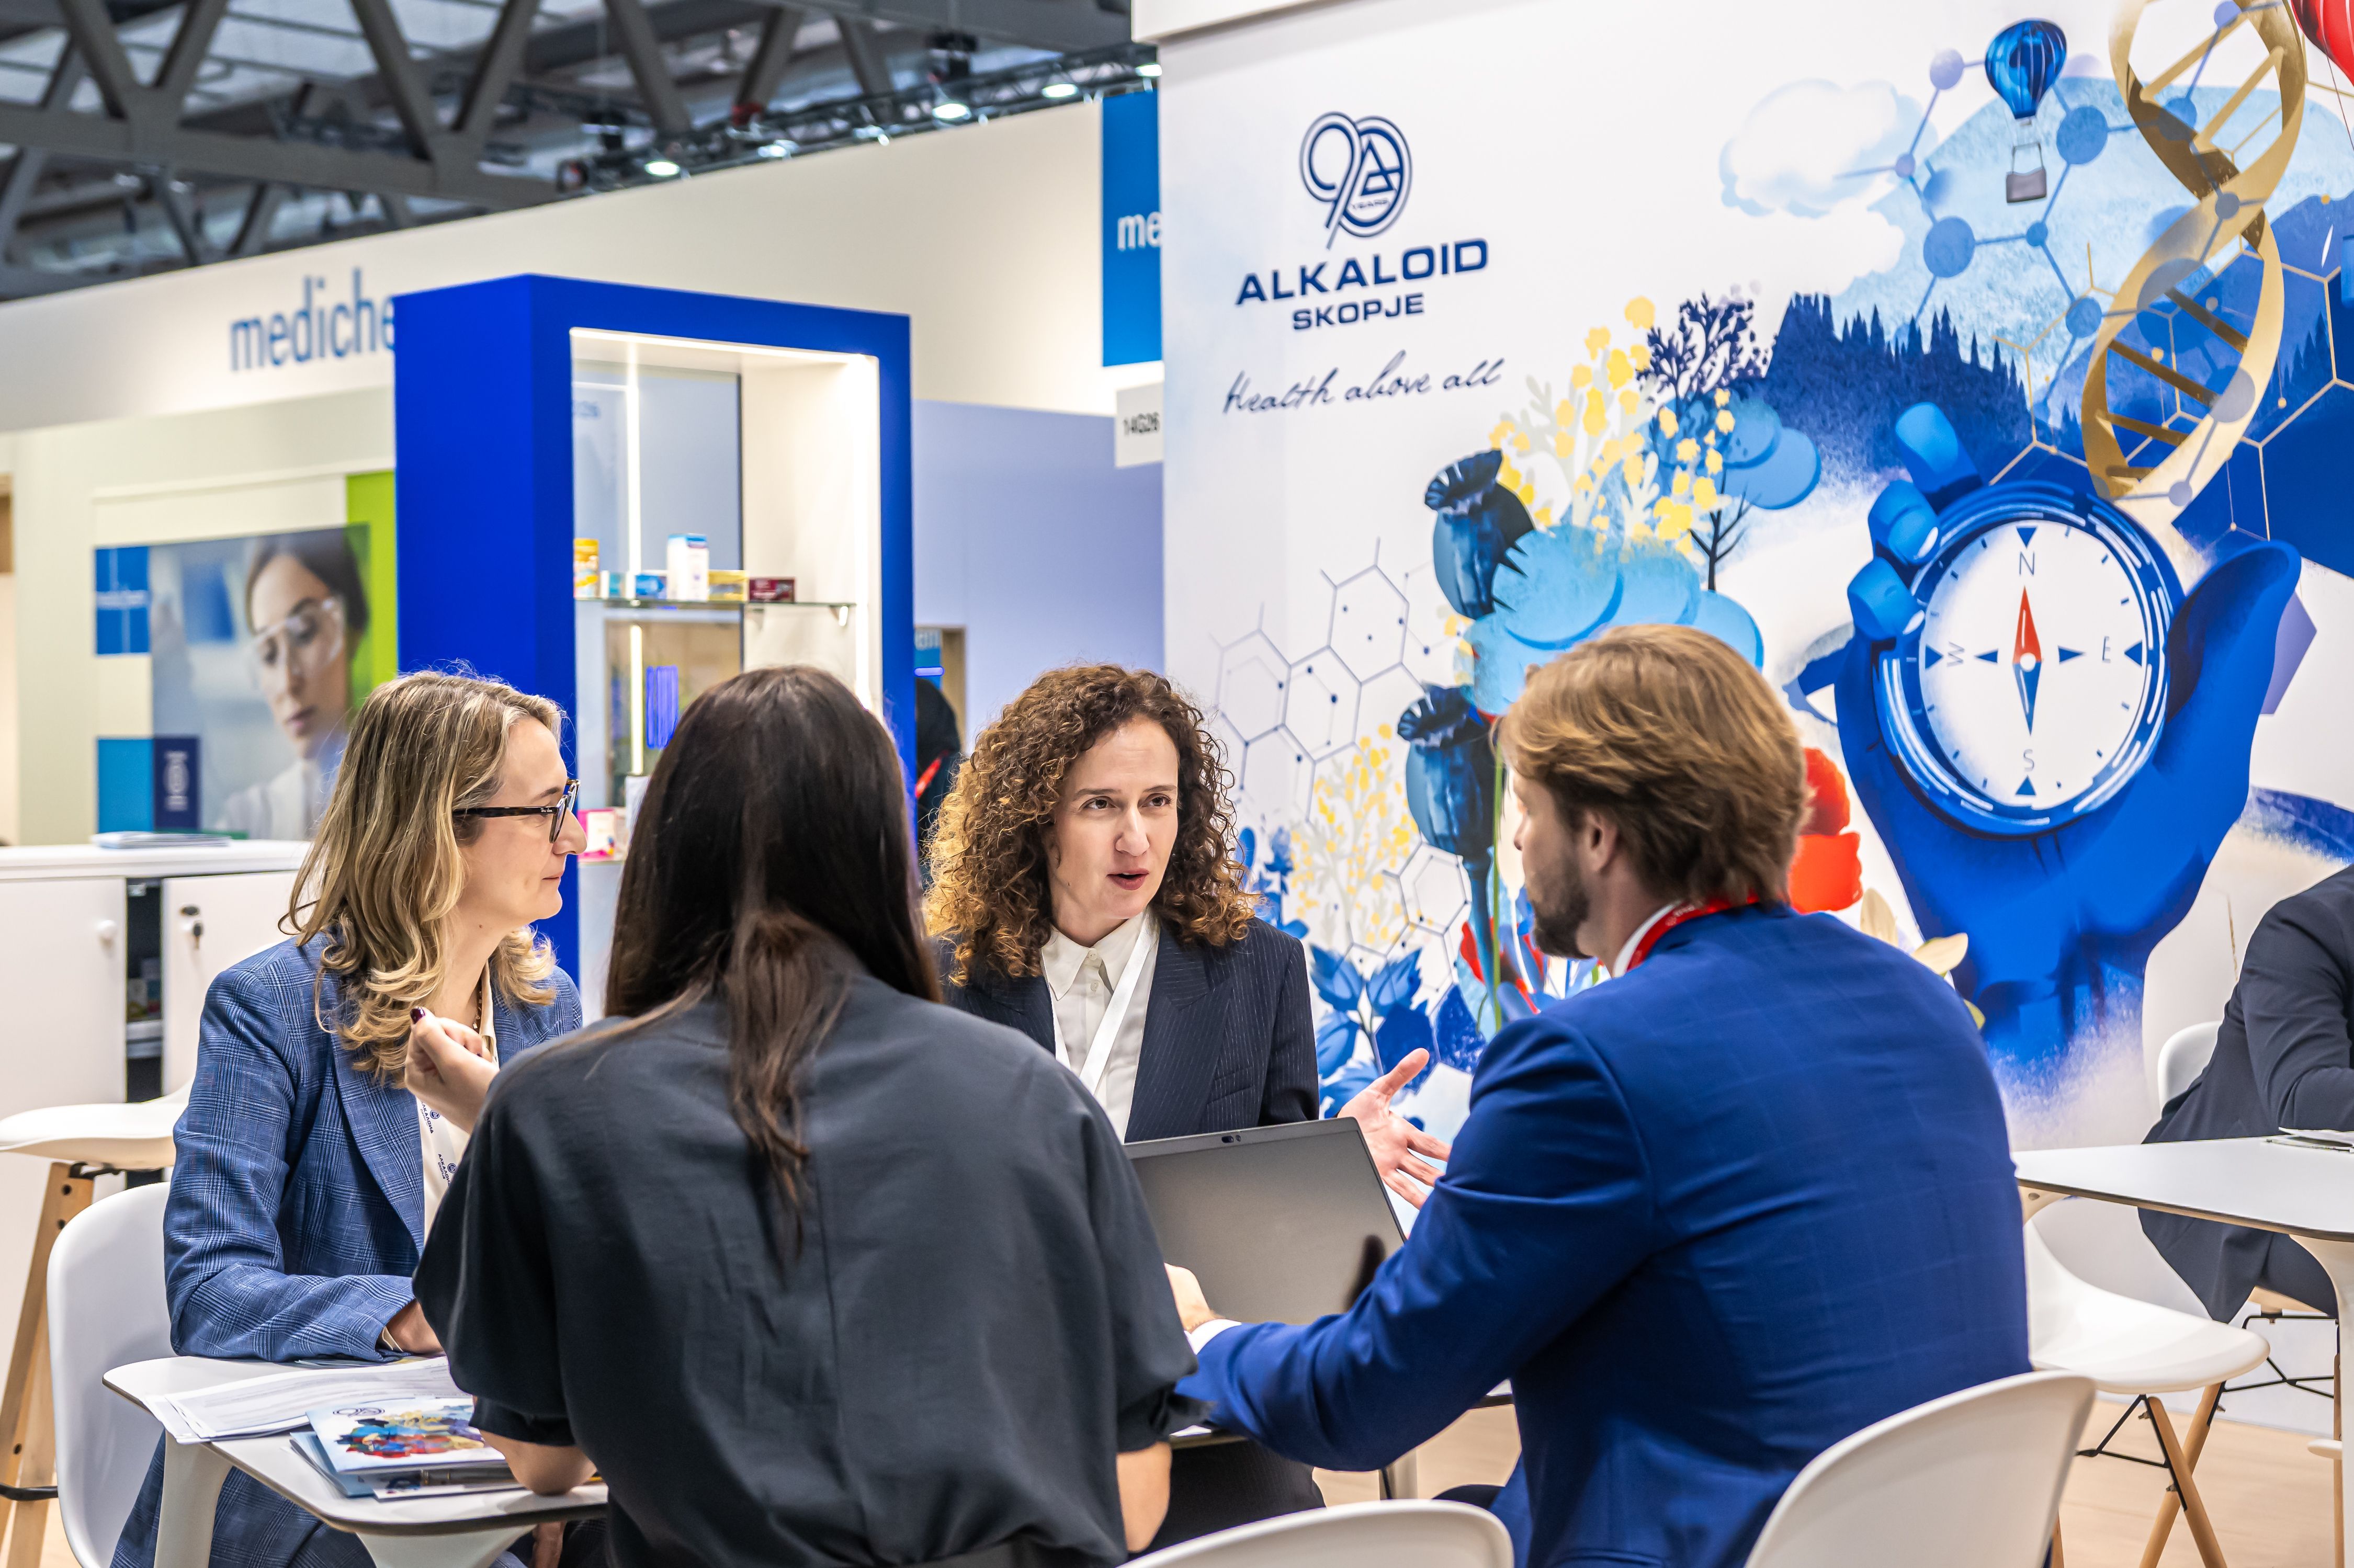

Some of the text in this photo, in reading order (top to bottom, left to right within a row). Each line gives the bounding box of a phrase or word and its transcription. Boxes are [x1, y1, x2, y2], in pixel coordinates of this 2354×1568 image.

[1235, 238, 1489, 305] ALKALOID
[1293, 293, 1424, 331] SKOPJE
[1223, 349, 1505, 414] Health above all
[2019, 552, 2035, 576] N
[1946, 636, 2111, 667] W E
[2023, 749, 2034, 772] S
[422, 1101, 434, 1134] ЛКАЛОИД
